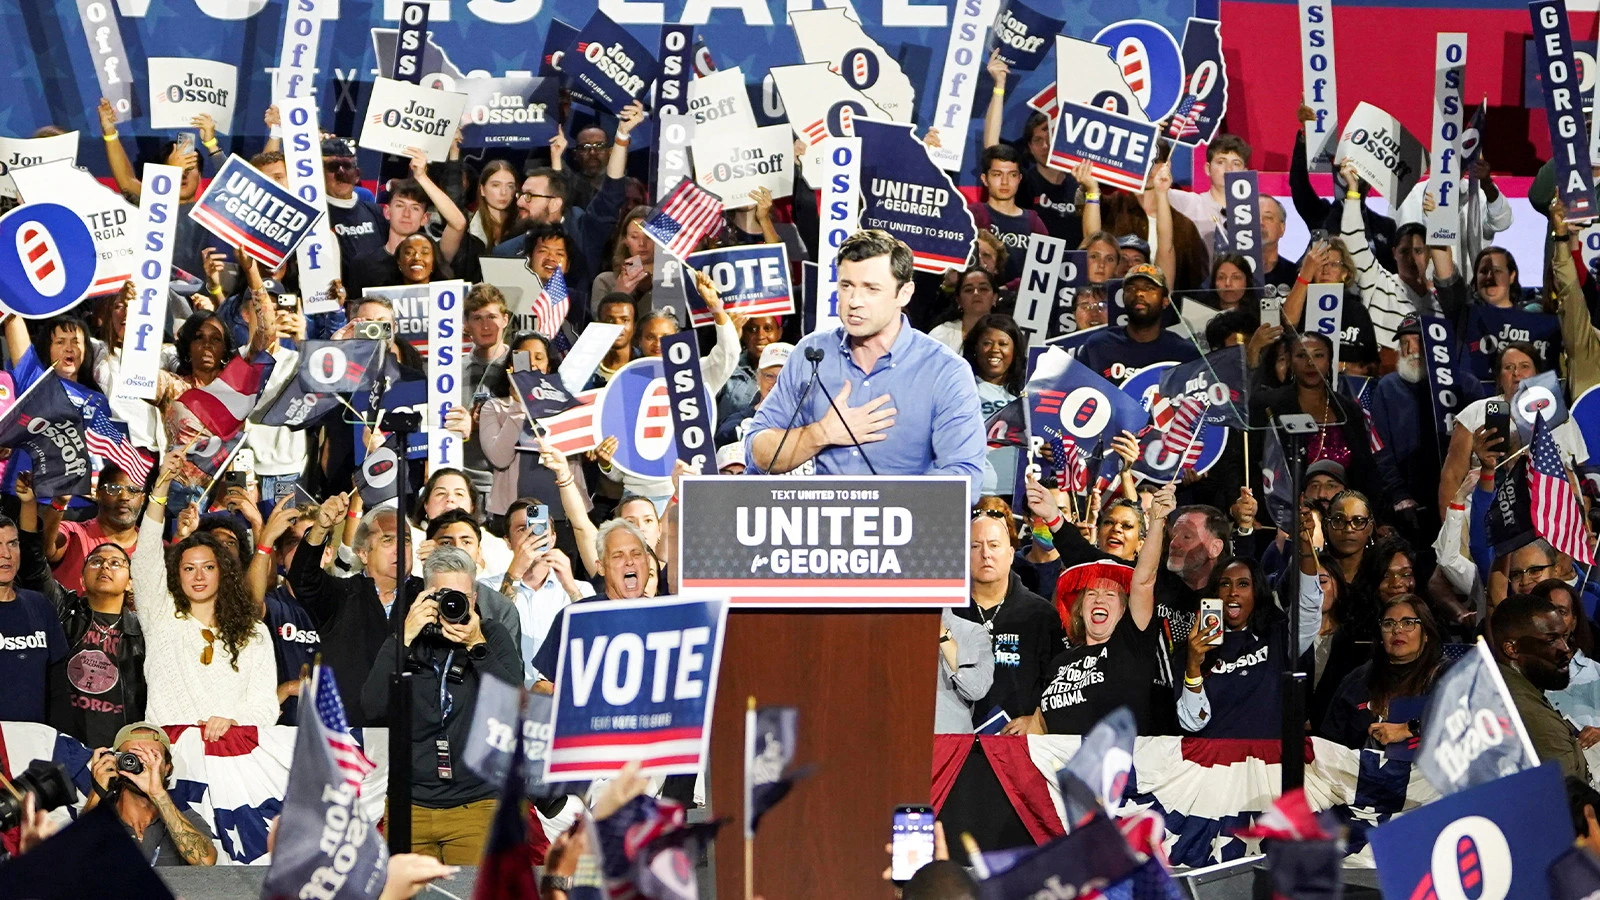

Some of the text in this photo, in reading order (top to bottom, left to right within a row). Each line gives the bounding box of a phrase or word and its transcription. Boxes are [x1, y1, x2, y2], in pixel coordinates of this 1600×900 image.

[584, 42, 645, 98] Ossoff
[606, 42, 635, 73] Jon
[184, 72, 213, 89] Jon
[166, 84, 229, 108] Ossoff
[404, 99, 435, 118] Jon
[489, 91, 523, 107] Jon
[690, 95, 712, 110] on
[1539, 6, 1587, 194] GEORGIA
[383, 108, 450, 137] Ossoff
[470, 103, 547, 125] Ossoff
[695, 96, 736, 125] soff
[1064, 112, 1149, 165] VOTE
[1373, 127, 1402, 156] Jon
[9, 152, 43, 167] Jon
[713, 153, 783, 182] Ossoff
[730, 147, 764, 163] Jon
[1350, 128, 1412, 181] Ossoff
[225, 171, 308, 232] UNITED
[871, 178, 949, 208] UNITED
[87, 208, 127, 230] TED
[884, 198, 941, 218] GEORGIA
[95, 227, 125, 242] RGIA
[224, 198, 295, 247] GEORGIA
[868, 218, 964, 240] TEXT UNITED TO 51015
[1019, 241, 1057, 343] UNIT
[1498, 323, 1530, 342] Jon
[27, 417, 87, 477] Ossoff
[54, 420, 85, 452] Jon
[771, 490, 879, 500] TEXT UNITED TO 51015
[736, 506, 913, 546] UNITED
[751, 548, 902, 575] for GEORGIA
[570, 626, 711, 708] VOTE
[1071, 671, 1104, 690] STATES
[1041, 696, 1049, 712] OF
